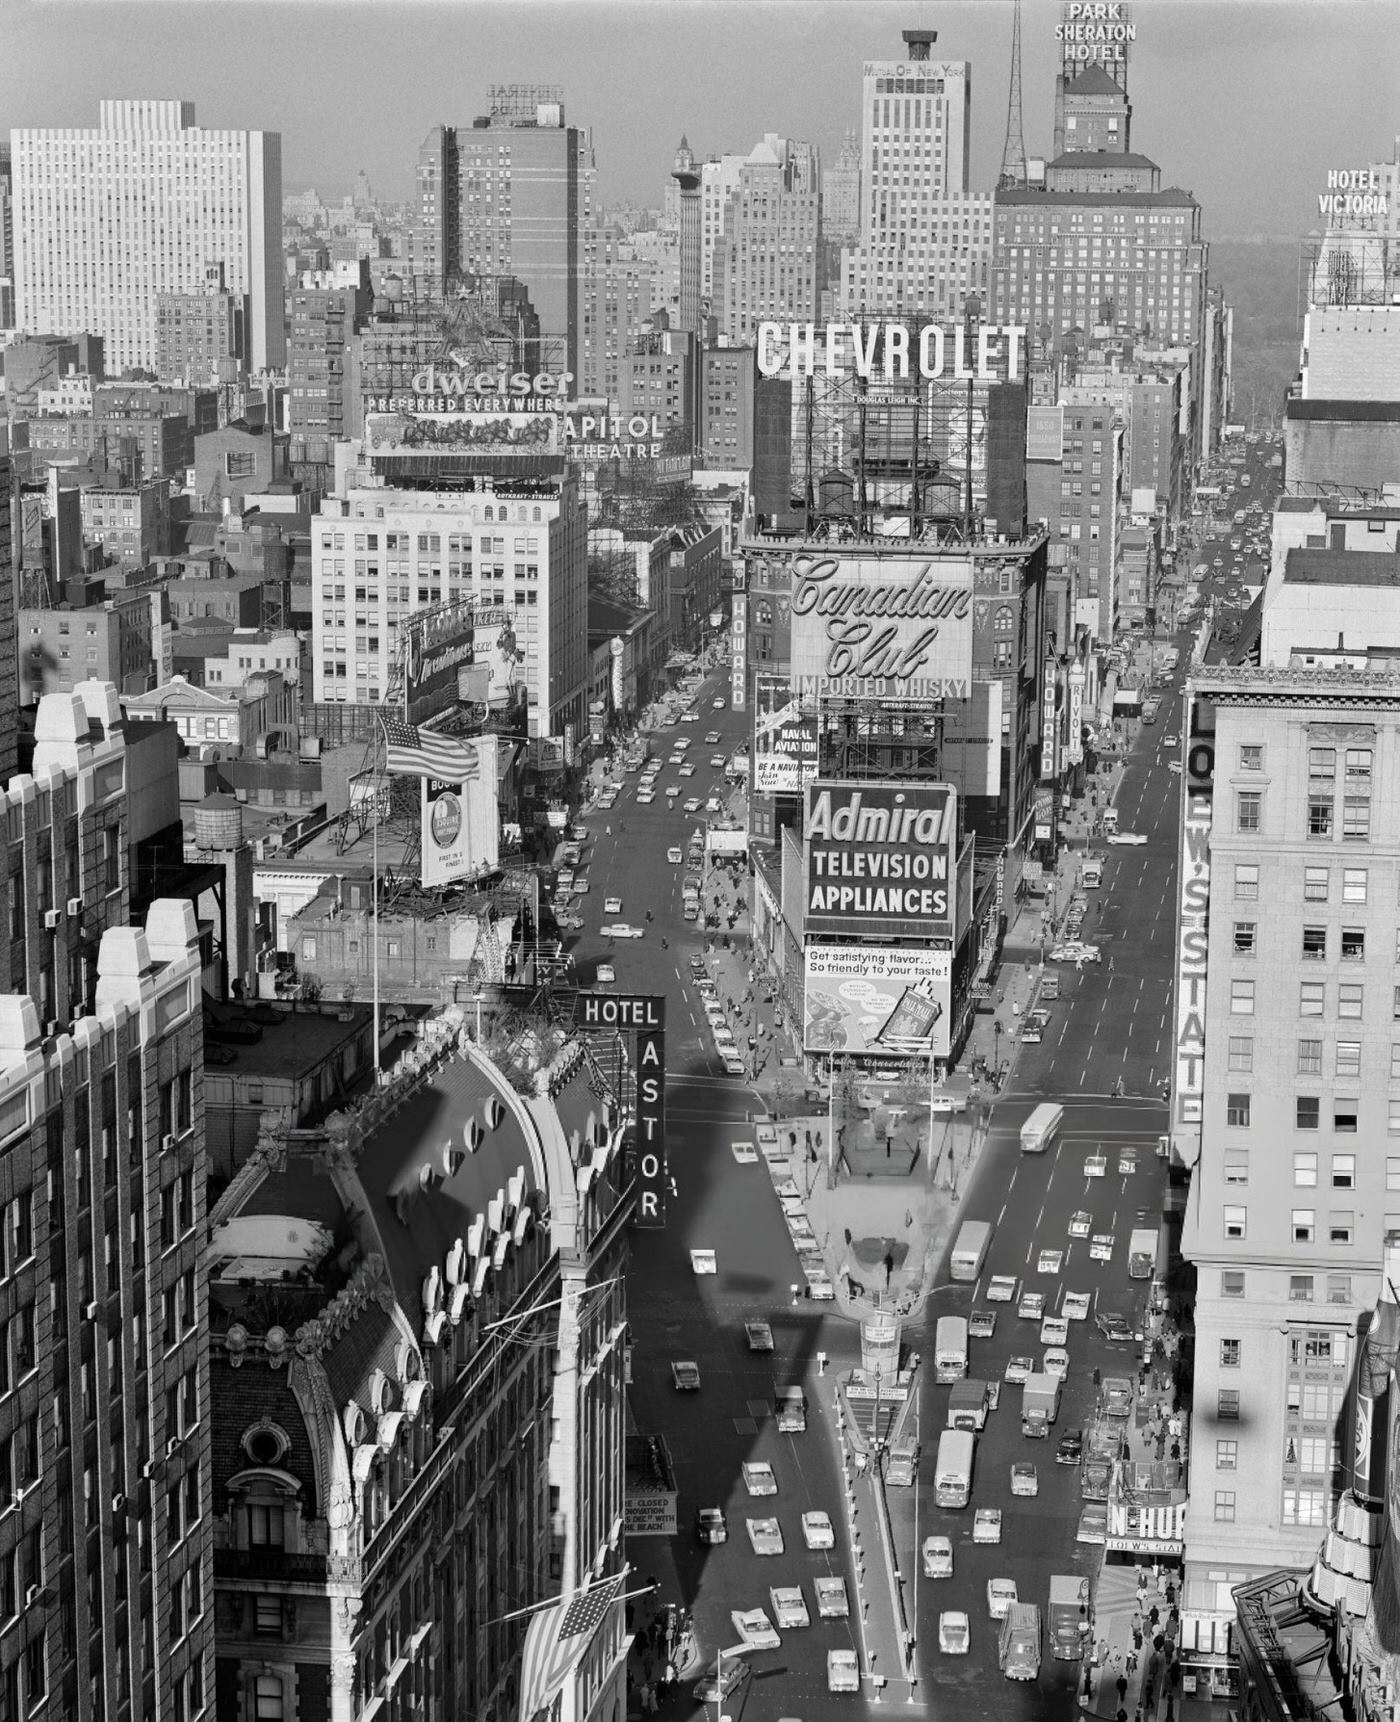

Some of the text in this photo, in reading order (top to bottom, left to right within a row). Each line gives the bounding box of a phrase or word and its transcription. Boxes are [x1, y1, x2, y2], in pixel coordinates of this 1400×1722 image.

[1070, 3, 1120, 19] PARK
[1055, 24, 1136, 41] SHERATON
[1064, 44, 1124, 60] HOTEL
[1327, 169, 1378, 189] HOTEL
[1318, 194, 1388, 214] VICTORIA
[757, 321, 1027, 379] CHEVROLET
[368, 399, 564, 412] PREFERRED EVERYWHERE
[571, 443, 661, 459] THEATRE
[792, 554, 972, 619] Canadian
[733, 602, 745, 705] HOWARD
[825, 618, 939, 680] Club
[794, 675, 968, 698] IMPORTED WHISKY
[1042, 669, 1055, 772] HOWARD
[1071, 686, 1081, 750] RIVOLI
[781, 729, 812, 740] NAVAL
[774, 741, 817, 753] AVIATION
[758, 763, 768, 771] BE
[770, 763, 776, 771] A
[805, 790, 956, 845] Admiral
[1183, 702, 1215, 912] LOEW'S
[813, 851, 947, 880] TELEVISION
[811, 885, 947, 914] APPLIANCES
[810, 951, 829, 960] Get
[832, 951, 885, 965] satisfying
[810, 963, 825, 972] So
[827, 963, 869, 976] friendly
[873, 965, 884, 974] to
[887, 966, 911, 976] your
[586, 1000, 658, 1023] HOTEL
[1178, 931, 1207, 1124] STATE
[642, 1041, 659, 1216] ASTOR
[638, 1499, 669, 1507] CLOSED
